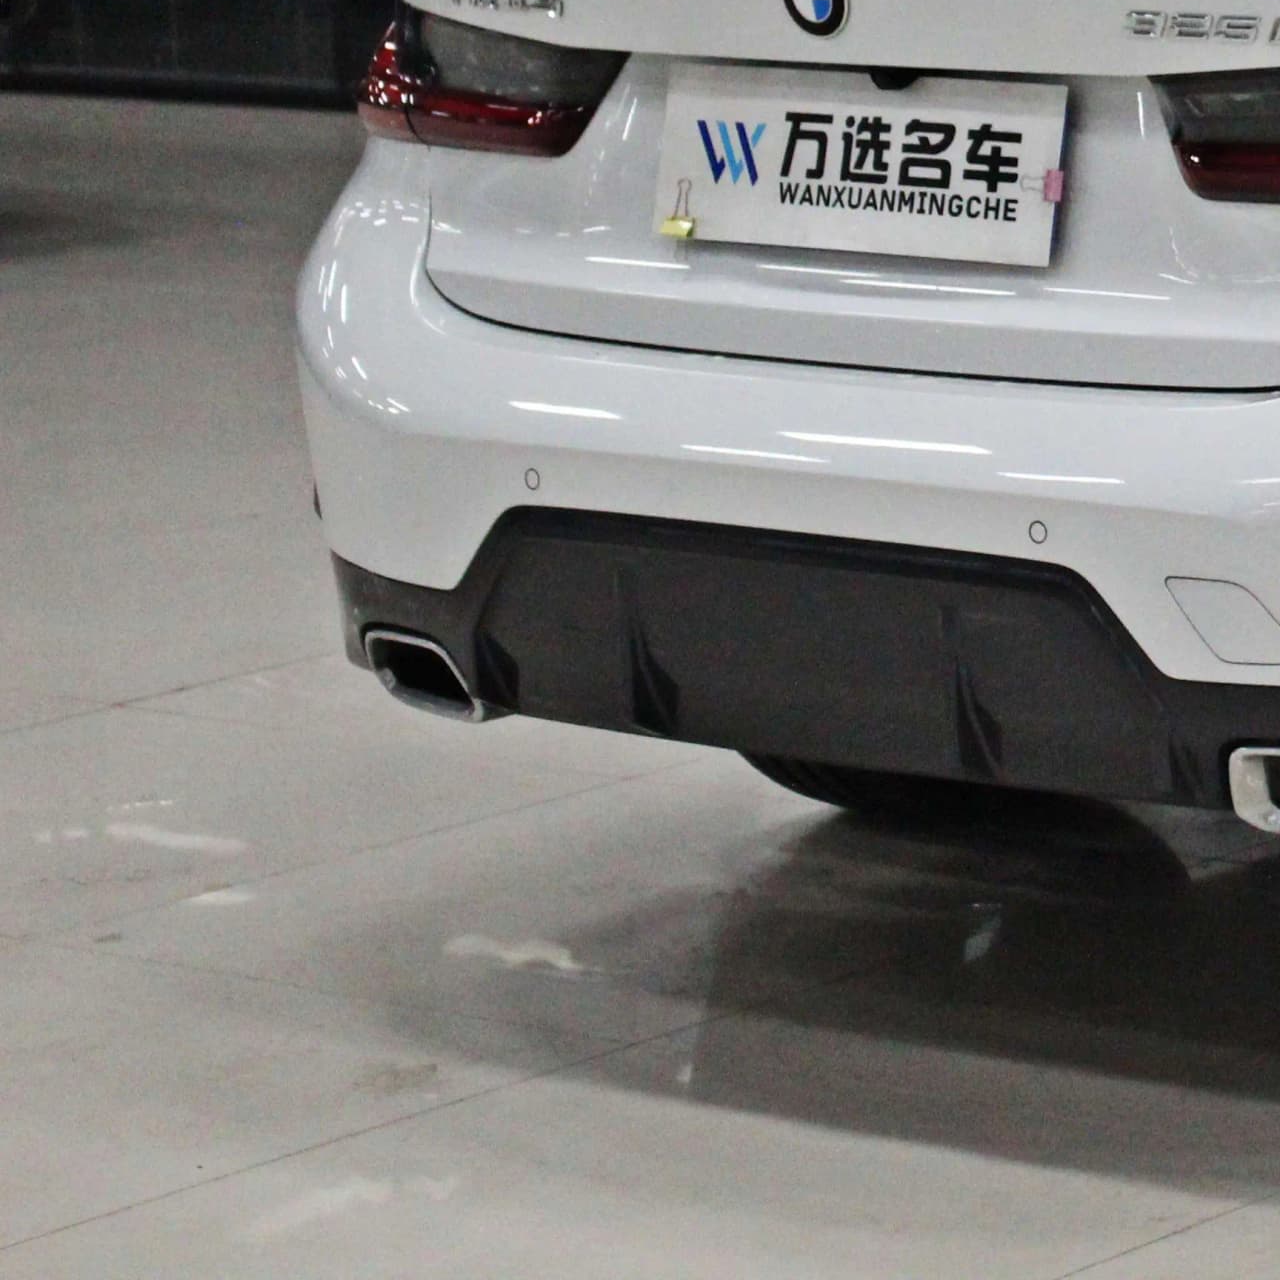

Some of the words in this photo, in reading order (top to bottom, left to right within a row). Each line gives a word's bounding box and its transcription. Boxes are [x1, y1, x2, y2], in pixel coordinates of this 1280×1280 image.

[780, 111, 1022, 192] 万选名车
[779, 182, 1018, 221] WANXUANMINGCHE
